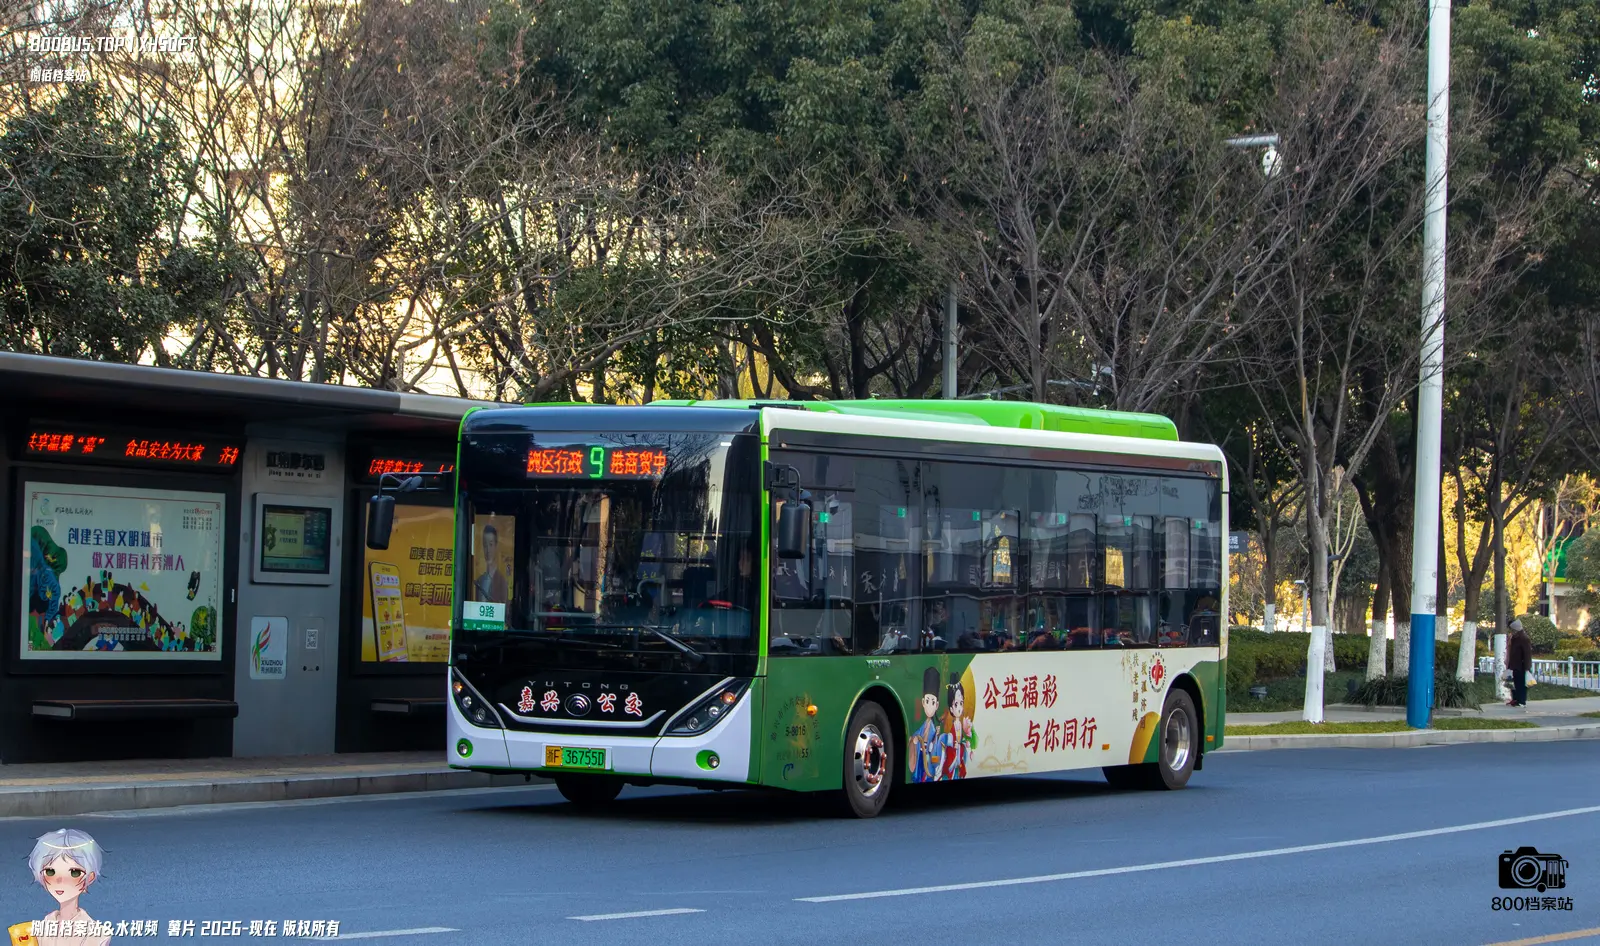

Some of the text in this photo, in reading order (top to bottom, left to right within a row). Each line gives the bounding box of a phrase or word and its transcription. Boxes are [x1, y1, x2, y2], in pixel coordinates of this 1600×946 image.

[125, 439, 205, 462] 食品安全为大家
[589, 446, 605, 478] 9
[610, 450, 668, 475] 港商贸中
[68, 528, 163, 548] 创建全国文明城市
[92, 552, 186, 571] 做文明有礼秀洲人
[479, 605, 495, 618] 9路
[528, 680, 629, 690] YUTONG
[983, 673, 1059, 710] 公益福彩
[518, 686, 643, 717] 嘉兴 公交
[1023, 717, 1098, 754] 与你同行
